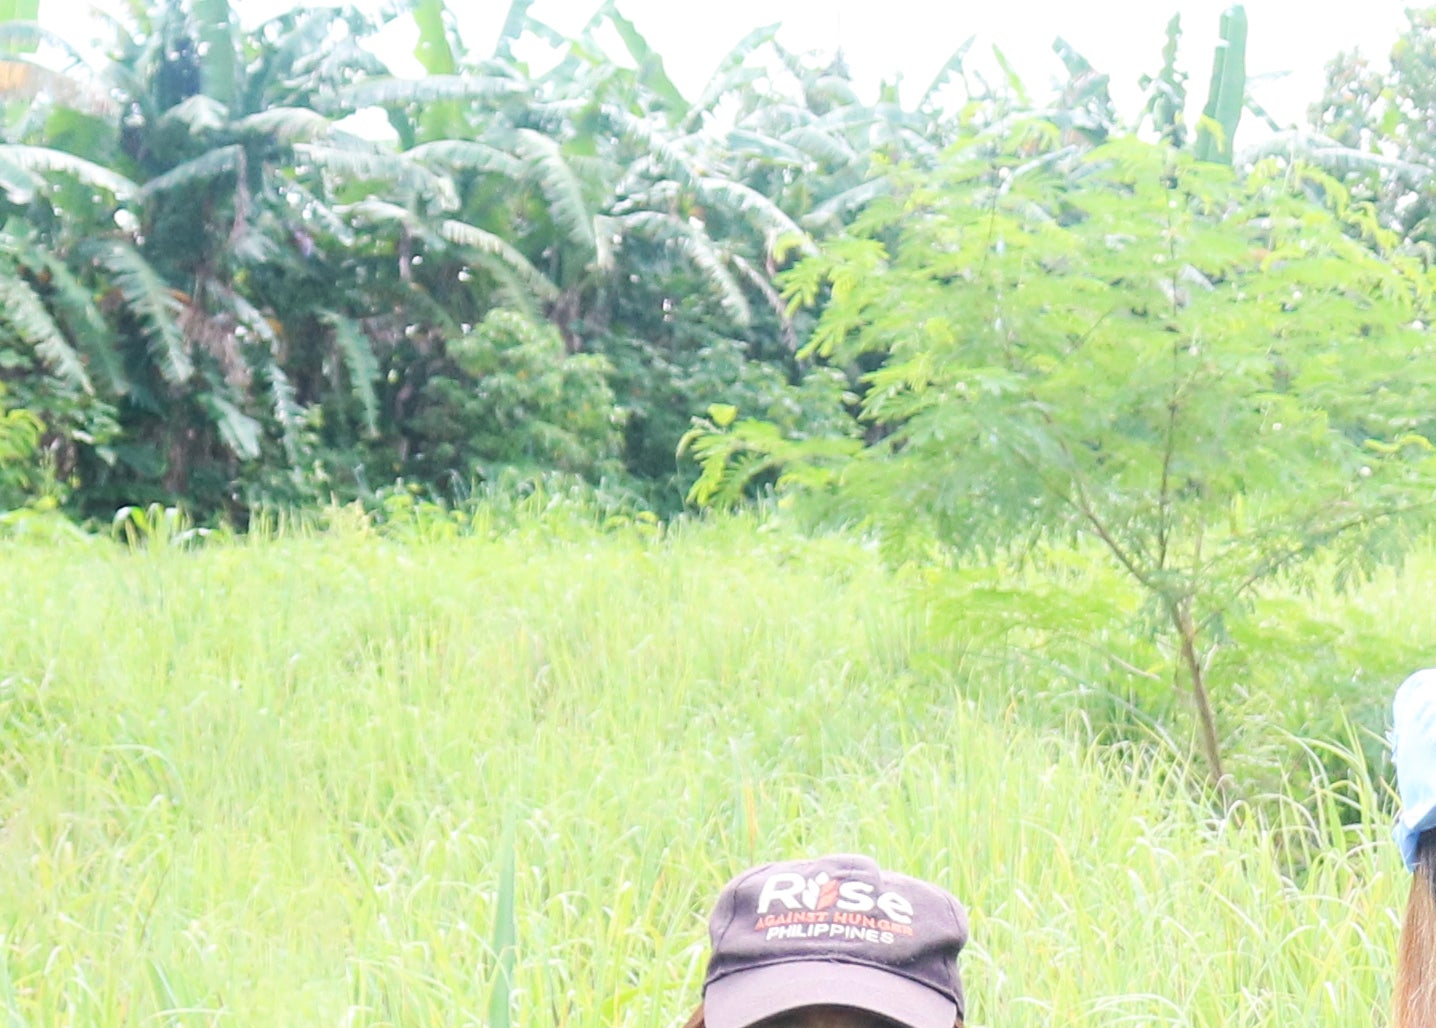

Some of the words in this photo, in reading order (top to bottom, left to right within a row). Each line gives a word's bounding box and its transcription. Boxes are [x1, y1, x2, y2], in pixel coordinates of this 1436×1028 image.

[757, 872, 914, 924] Rise
[755, 911, 829, 930] AGAINST
[832, 911, 913, 936] HUNGER
[766, 923, 895, 945] PHILIPPINES
